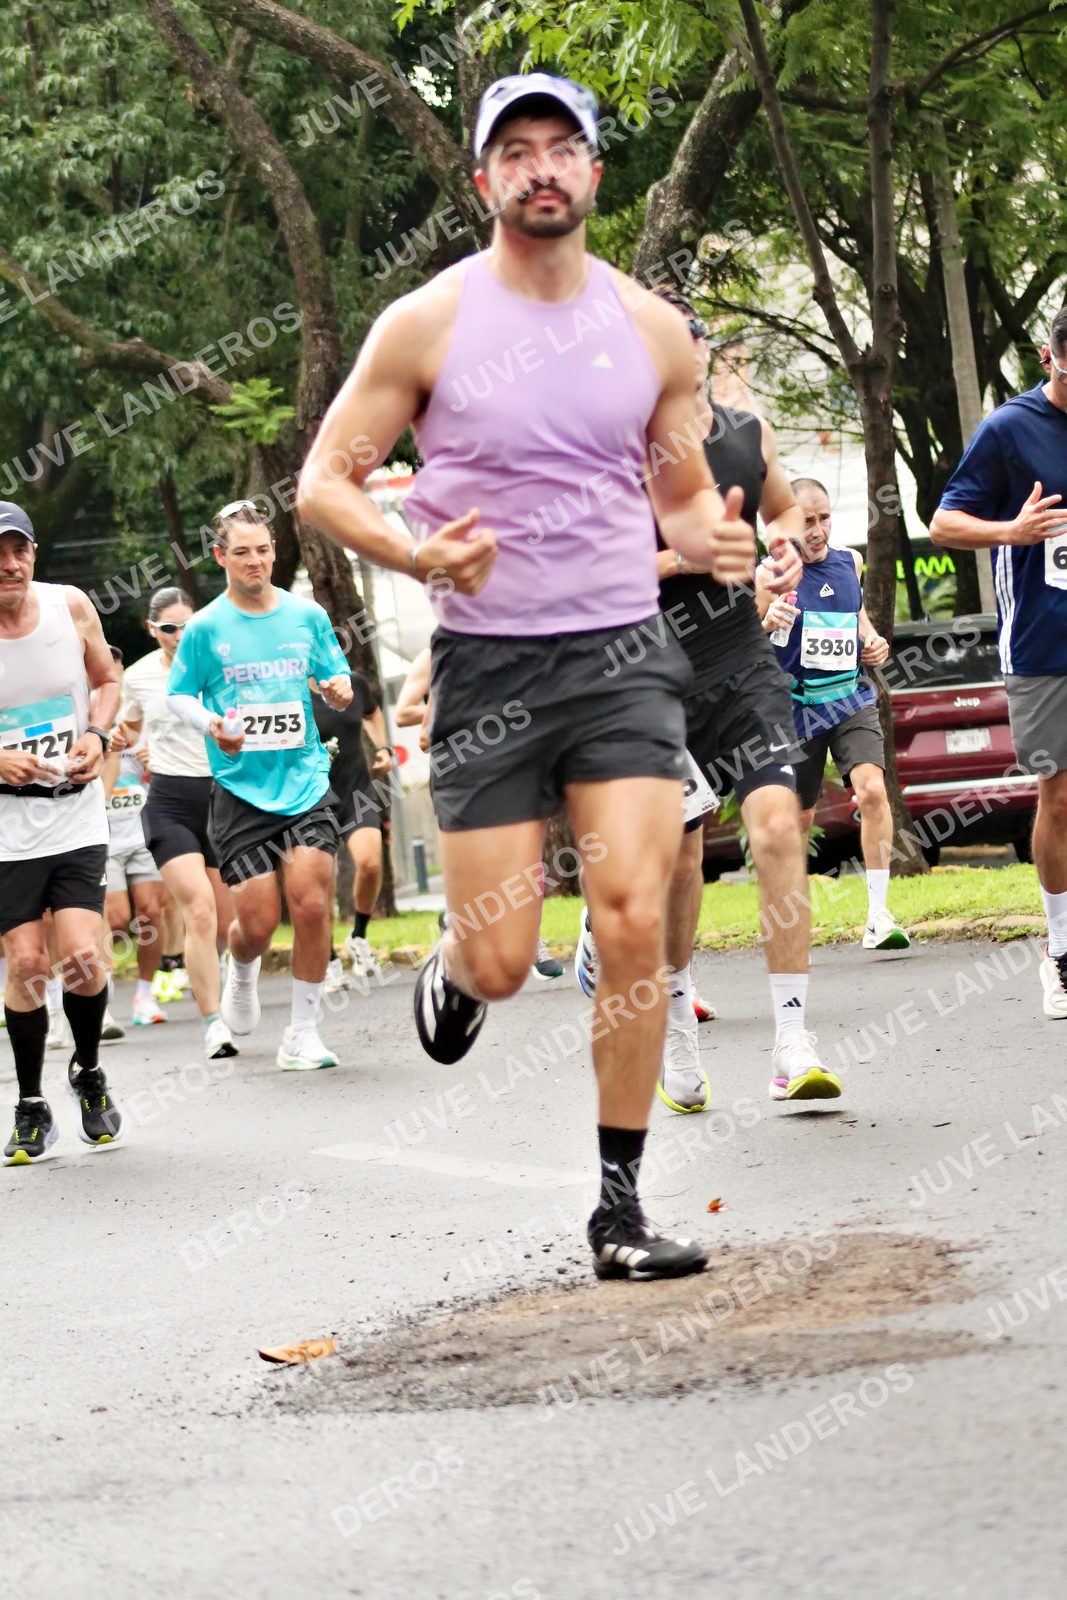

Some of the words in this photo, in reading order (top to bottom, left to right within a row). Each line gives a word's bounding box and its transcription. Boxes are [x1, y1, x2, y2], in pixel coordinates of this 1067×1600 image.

[806, 638, 855, 656] 3930
[954, 697, 981, 707] Jeep
[243, 713, 301, 735] 2753
[3, 729, 74, 759] 727
[106, 793, 142, 810] 628
